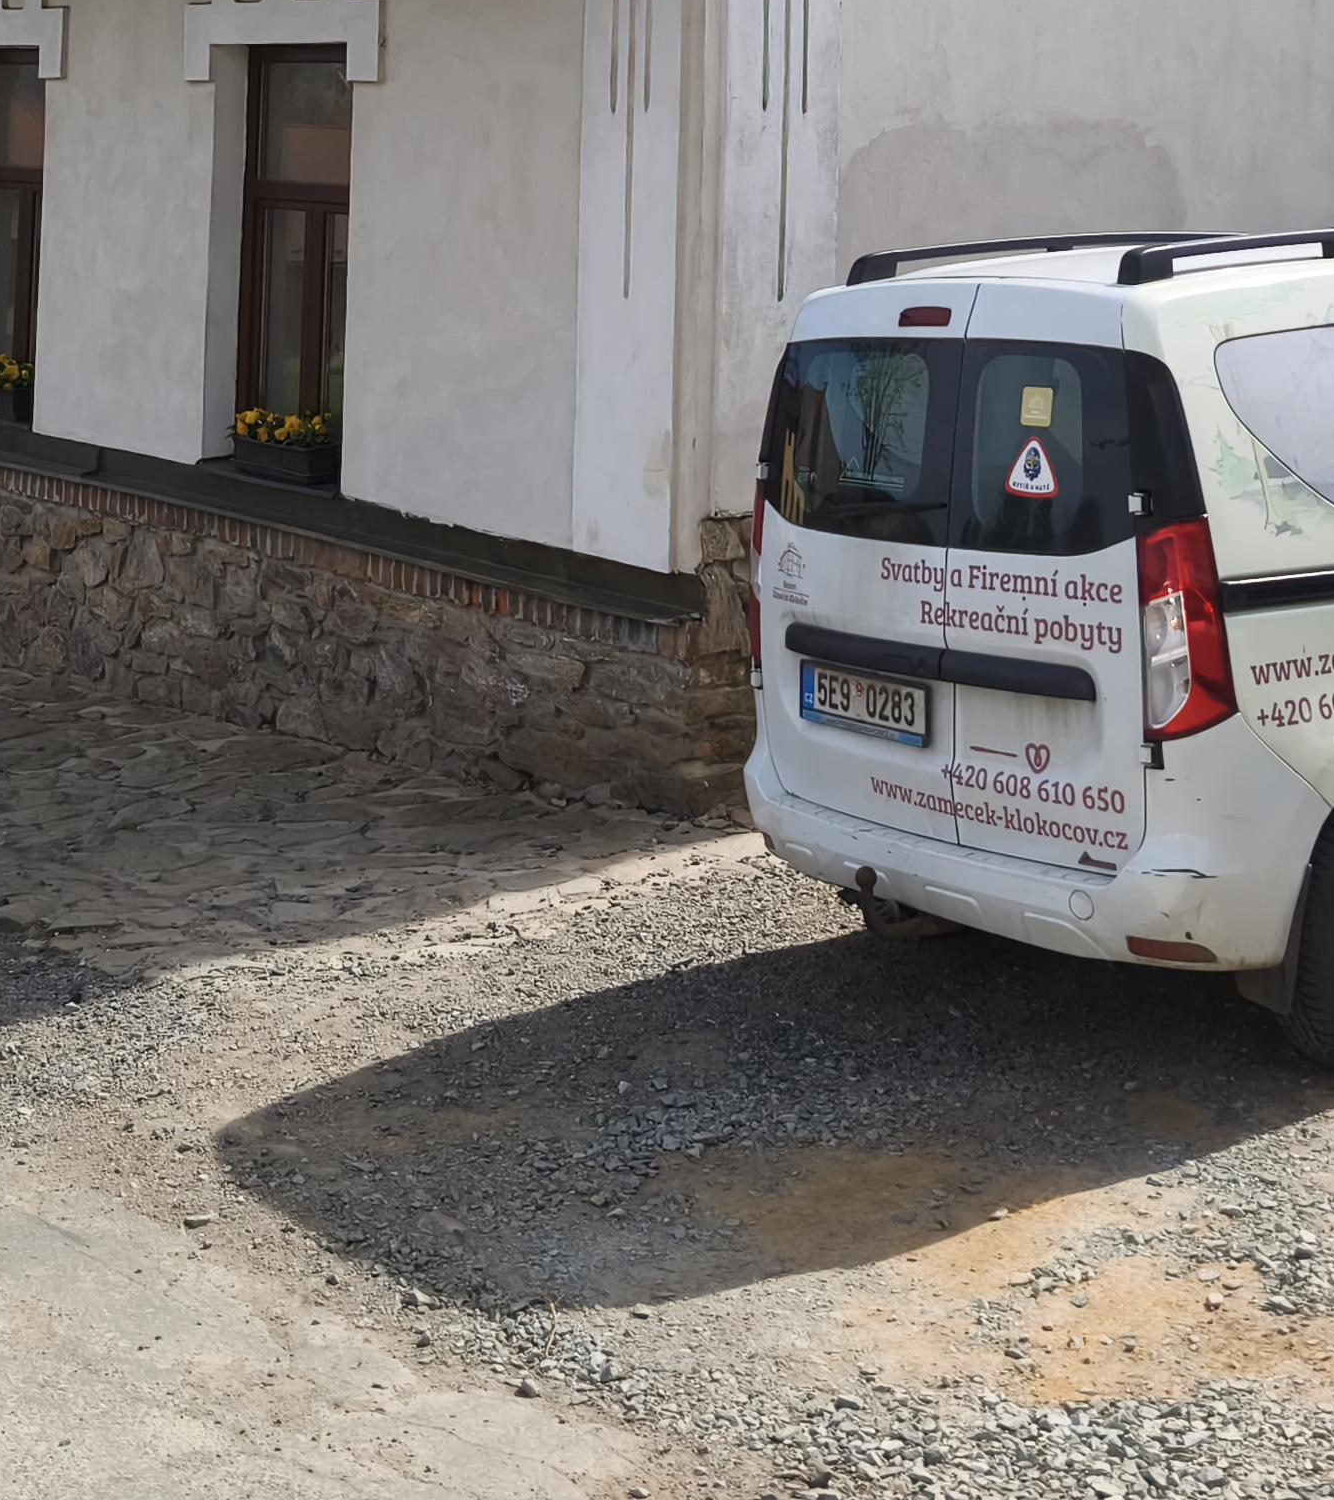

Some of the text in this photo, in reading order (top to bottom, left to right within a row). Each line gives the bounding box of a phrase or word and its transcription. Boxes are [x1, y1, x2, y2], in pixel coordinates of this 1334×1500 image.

[880, 556, 1123, 604] Svatby a Firemní akce
[920, 600, 1123, 653] Rekreační pobyty
[817, 671, 915, 727] 5E9 0283
[1256, 697, 1312, 728] +420
[870, 776, 1129, 850] www.zamecek-klokocov.cz
[941, 763, 1125, 814] +420 608 610 650
